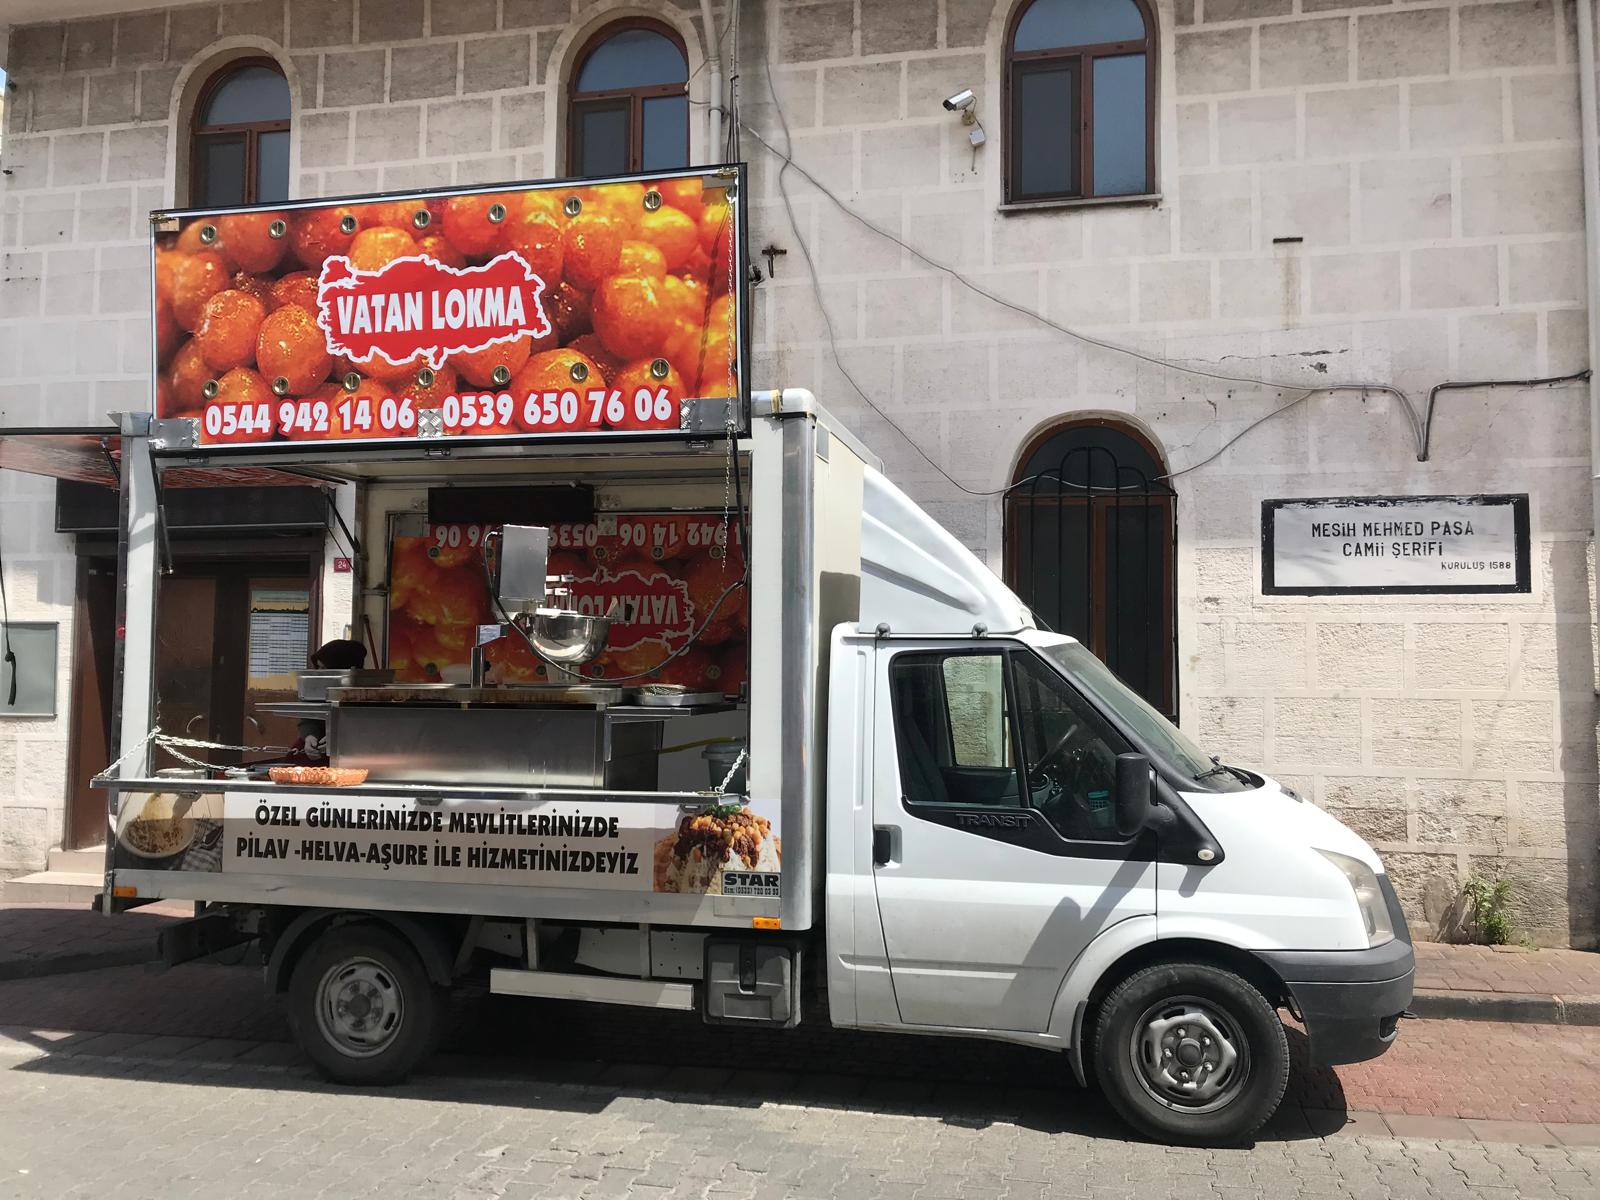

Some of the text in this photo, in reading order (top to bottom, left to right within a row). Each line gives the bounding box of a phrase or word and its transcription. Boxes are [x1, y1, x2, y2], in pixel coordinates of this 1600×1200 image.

[337, 286, 526, 334] VATAN LOKMA
[206, 388, 672, 435] 0544 942 14 06 0539 650 76 06
[1363, 521, 1424, 537] MEHMED
[1431, 520, 1474, 536] PASA
[337, 560, 347, 569] 24
[1489, 561, 1511, 570] 1588
[255, 799, 619, 838] ÖZEL GÜNLERİNİZDE MEVLİTLERİNİZDE
[955, 813, 1032, 828] TRANSIT
[236, 831, 289, 859] PİLAV
[434, 839, 461, 867] İLE
[467, 840, 639, 875] HİZMETİNİZDEYİZ
[724, 872, 779, 887] STAR
